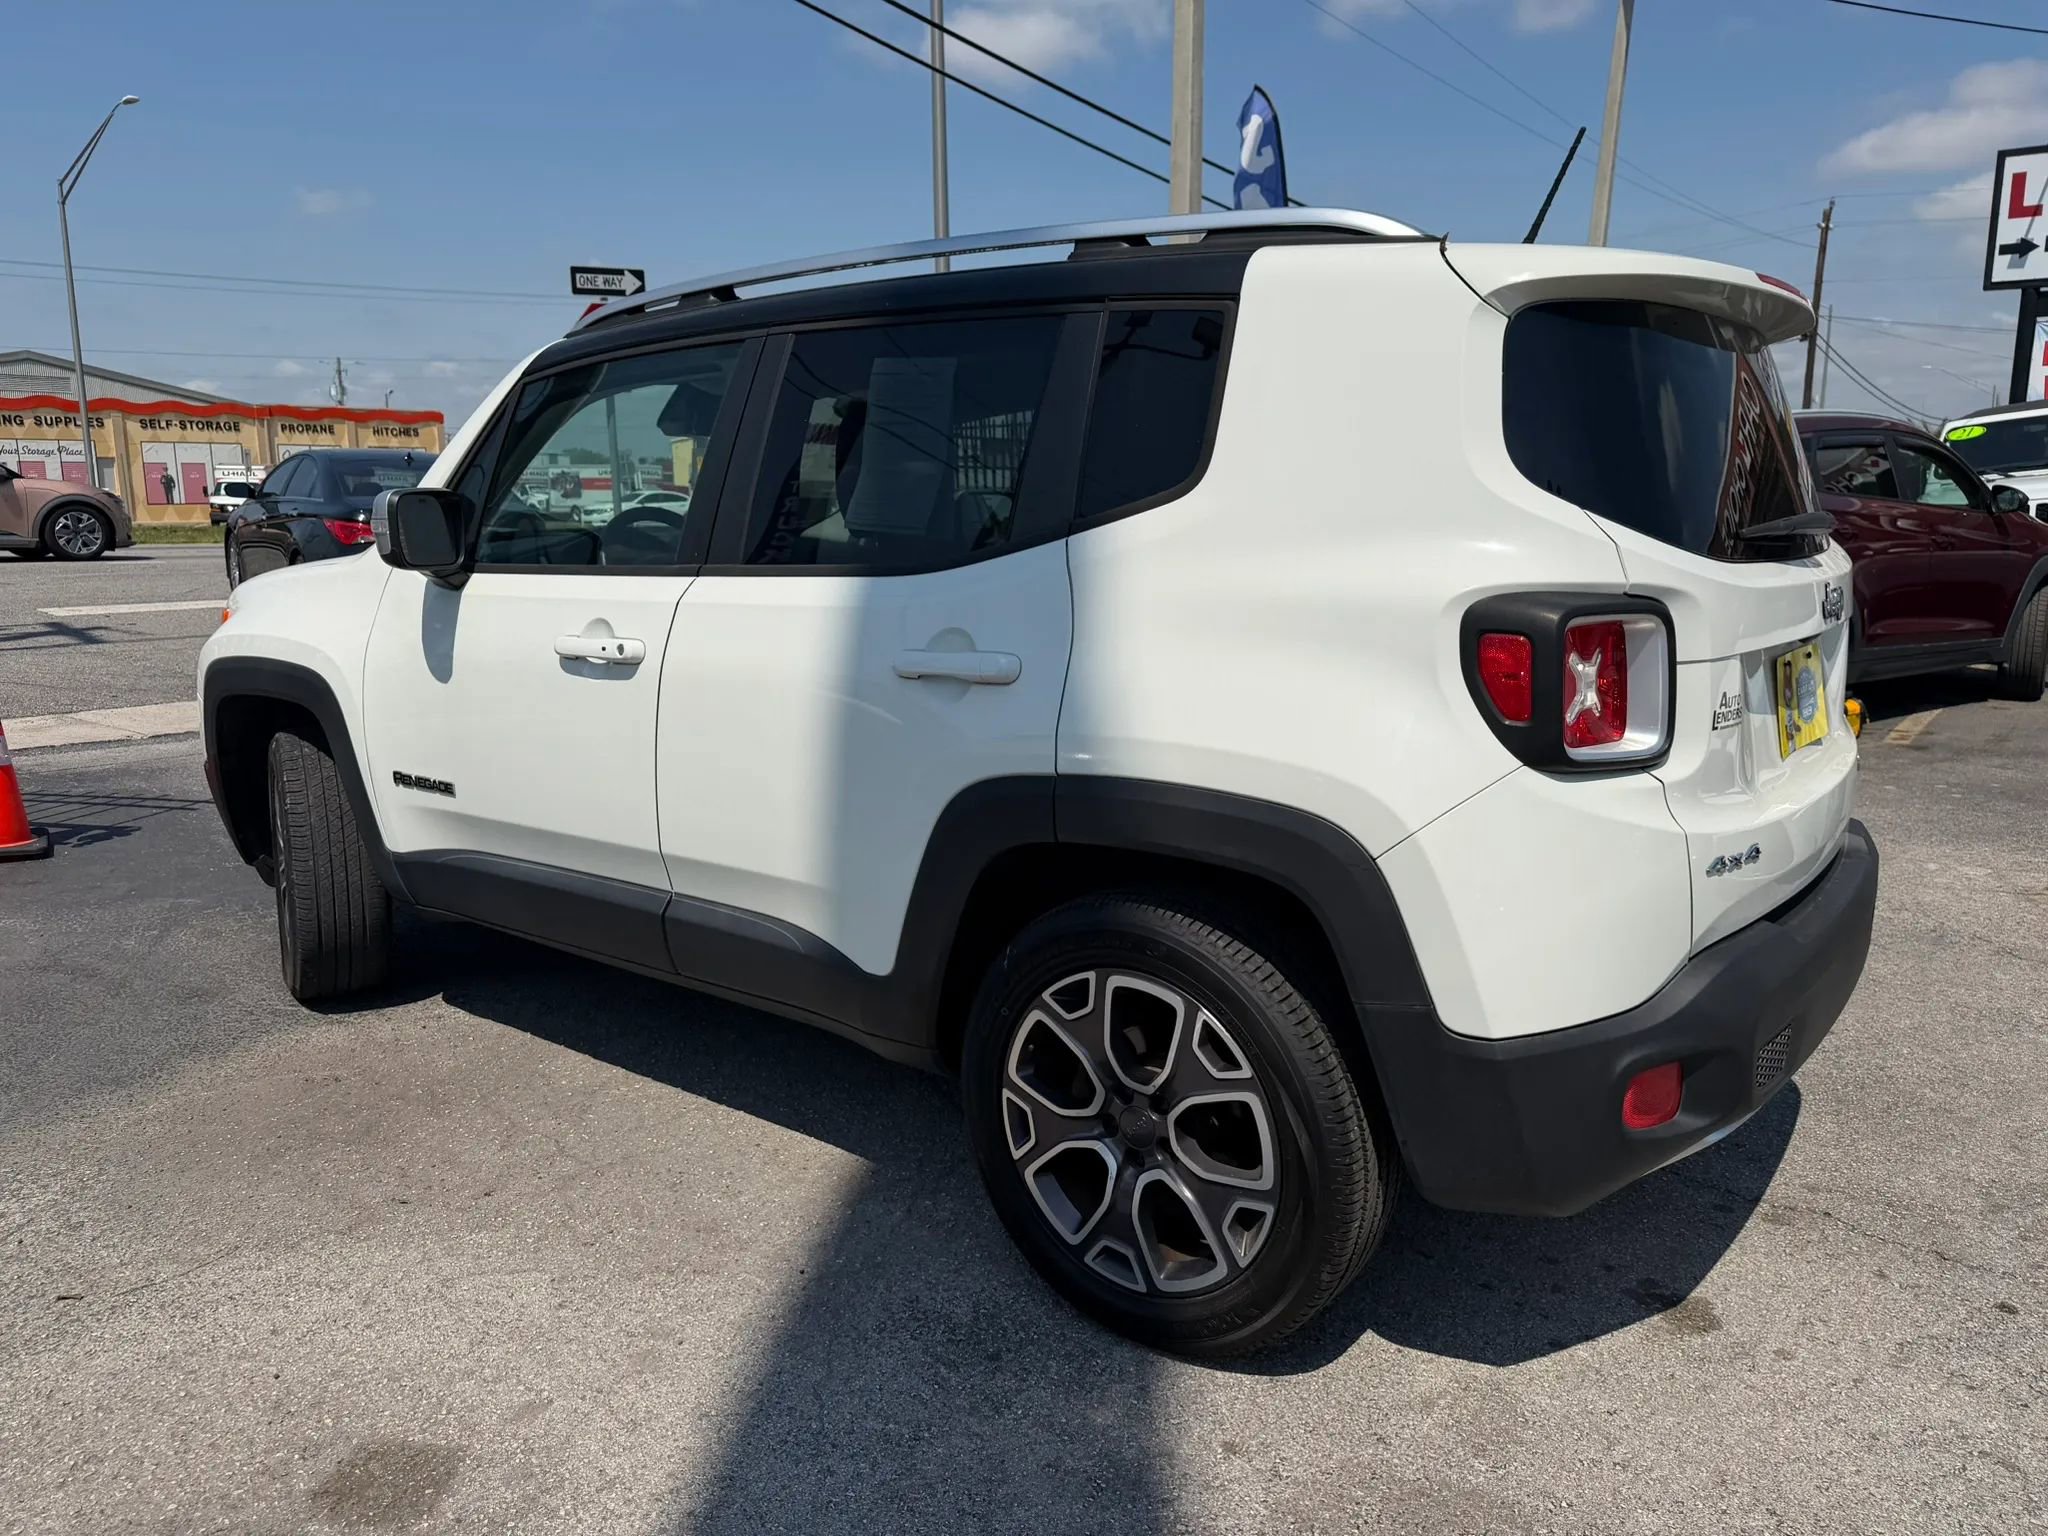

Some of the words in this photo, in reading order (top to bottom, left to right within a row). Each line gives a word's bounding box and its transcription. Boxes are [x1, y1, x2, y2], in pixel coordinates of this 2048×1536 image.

[579, 275, 600, 287] ONE
[602, 276, 624, 289] WAY
[34, 415, 104, 428] SUPPLES
[280, 424, 335, 435] PROPANE
[373, 426, 419, 437] HITCHES
[20, 445, 56, 457] Storage
[60, 445, 84, 456] Place
[392, 771, 456, 797] RENEGADE
